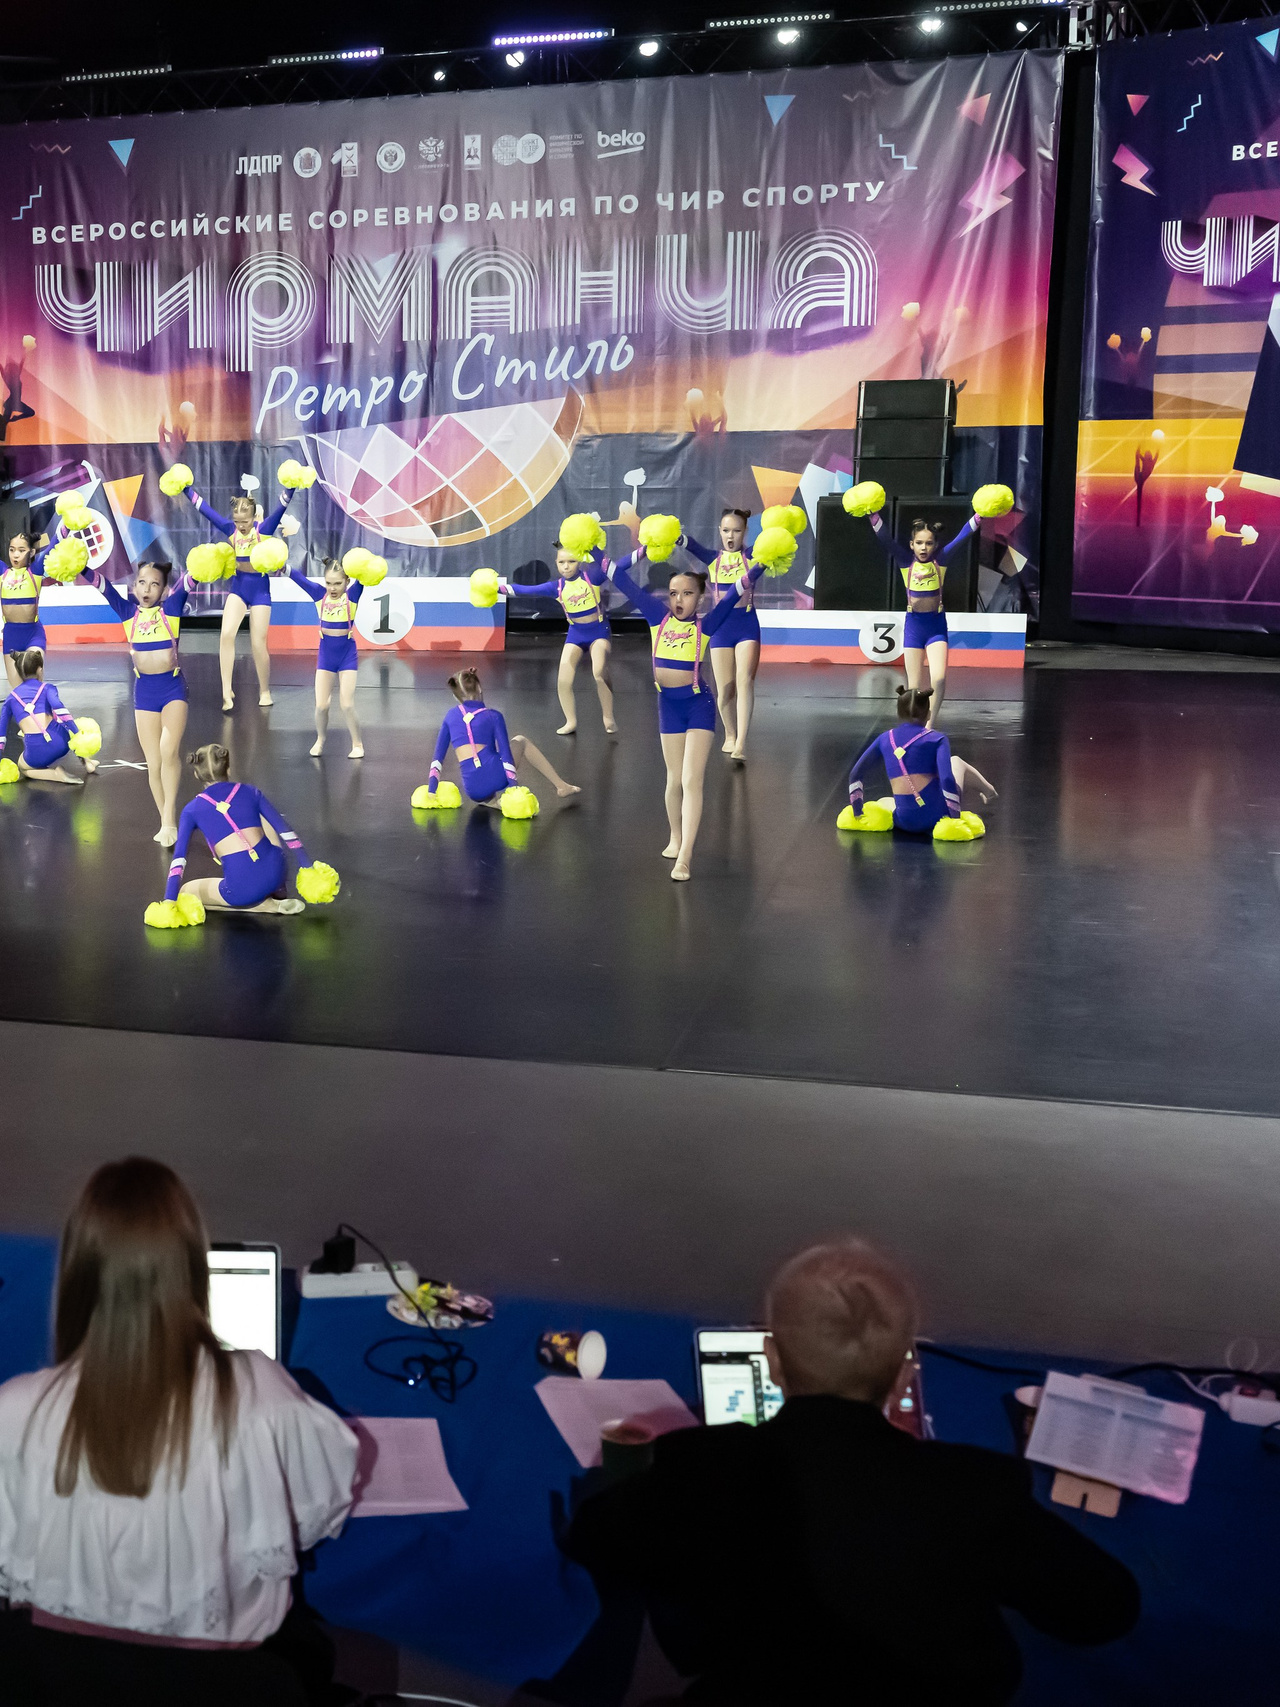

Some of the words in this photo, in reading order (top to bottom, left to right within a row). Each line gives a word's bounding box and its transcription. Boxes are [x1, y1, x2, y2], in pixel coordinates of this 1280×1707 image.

[597, 130, 646, 147] beko
[235, 154, 284, 177] ЛДПР
[32, 212, 293, 245] ВСЕРОССИЙСКИЕ
[308, 197, 577, 230] СОРЕВНОВАНИЯ
[594, 193, 639, 215] ПО
[656, 189, 725, 212] ЧИР
[742, 180, 886, 208] СПОРТУ
[255, 362, 428, 434] Ретро
[450, 333, 635, 402] Стиль
[372, 593, 396, 634] 1
[871, 623, 896, 654] 3
